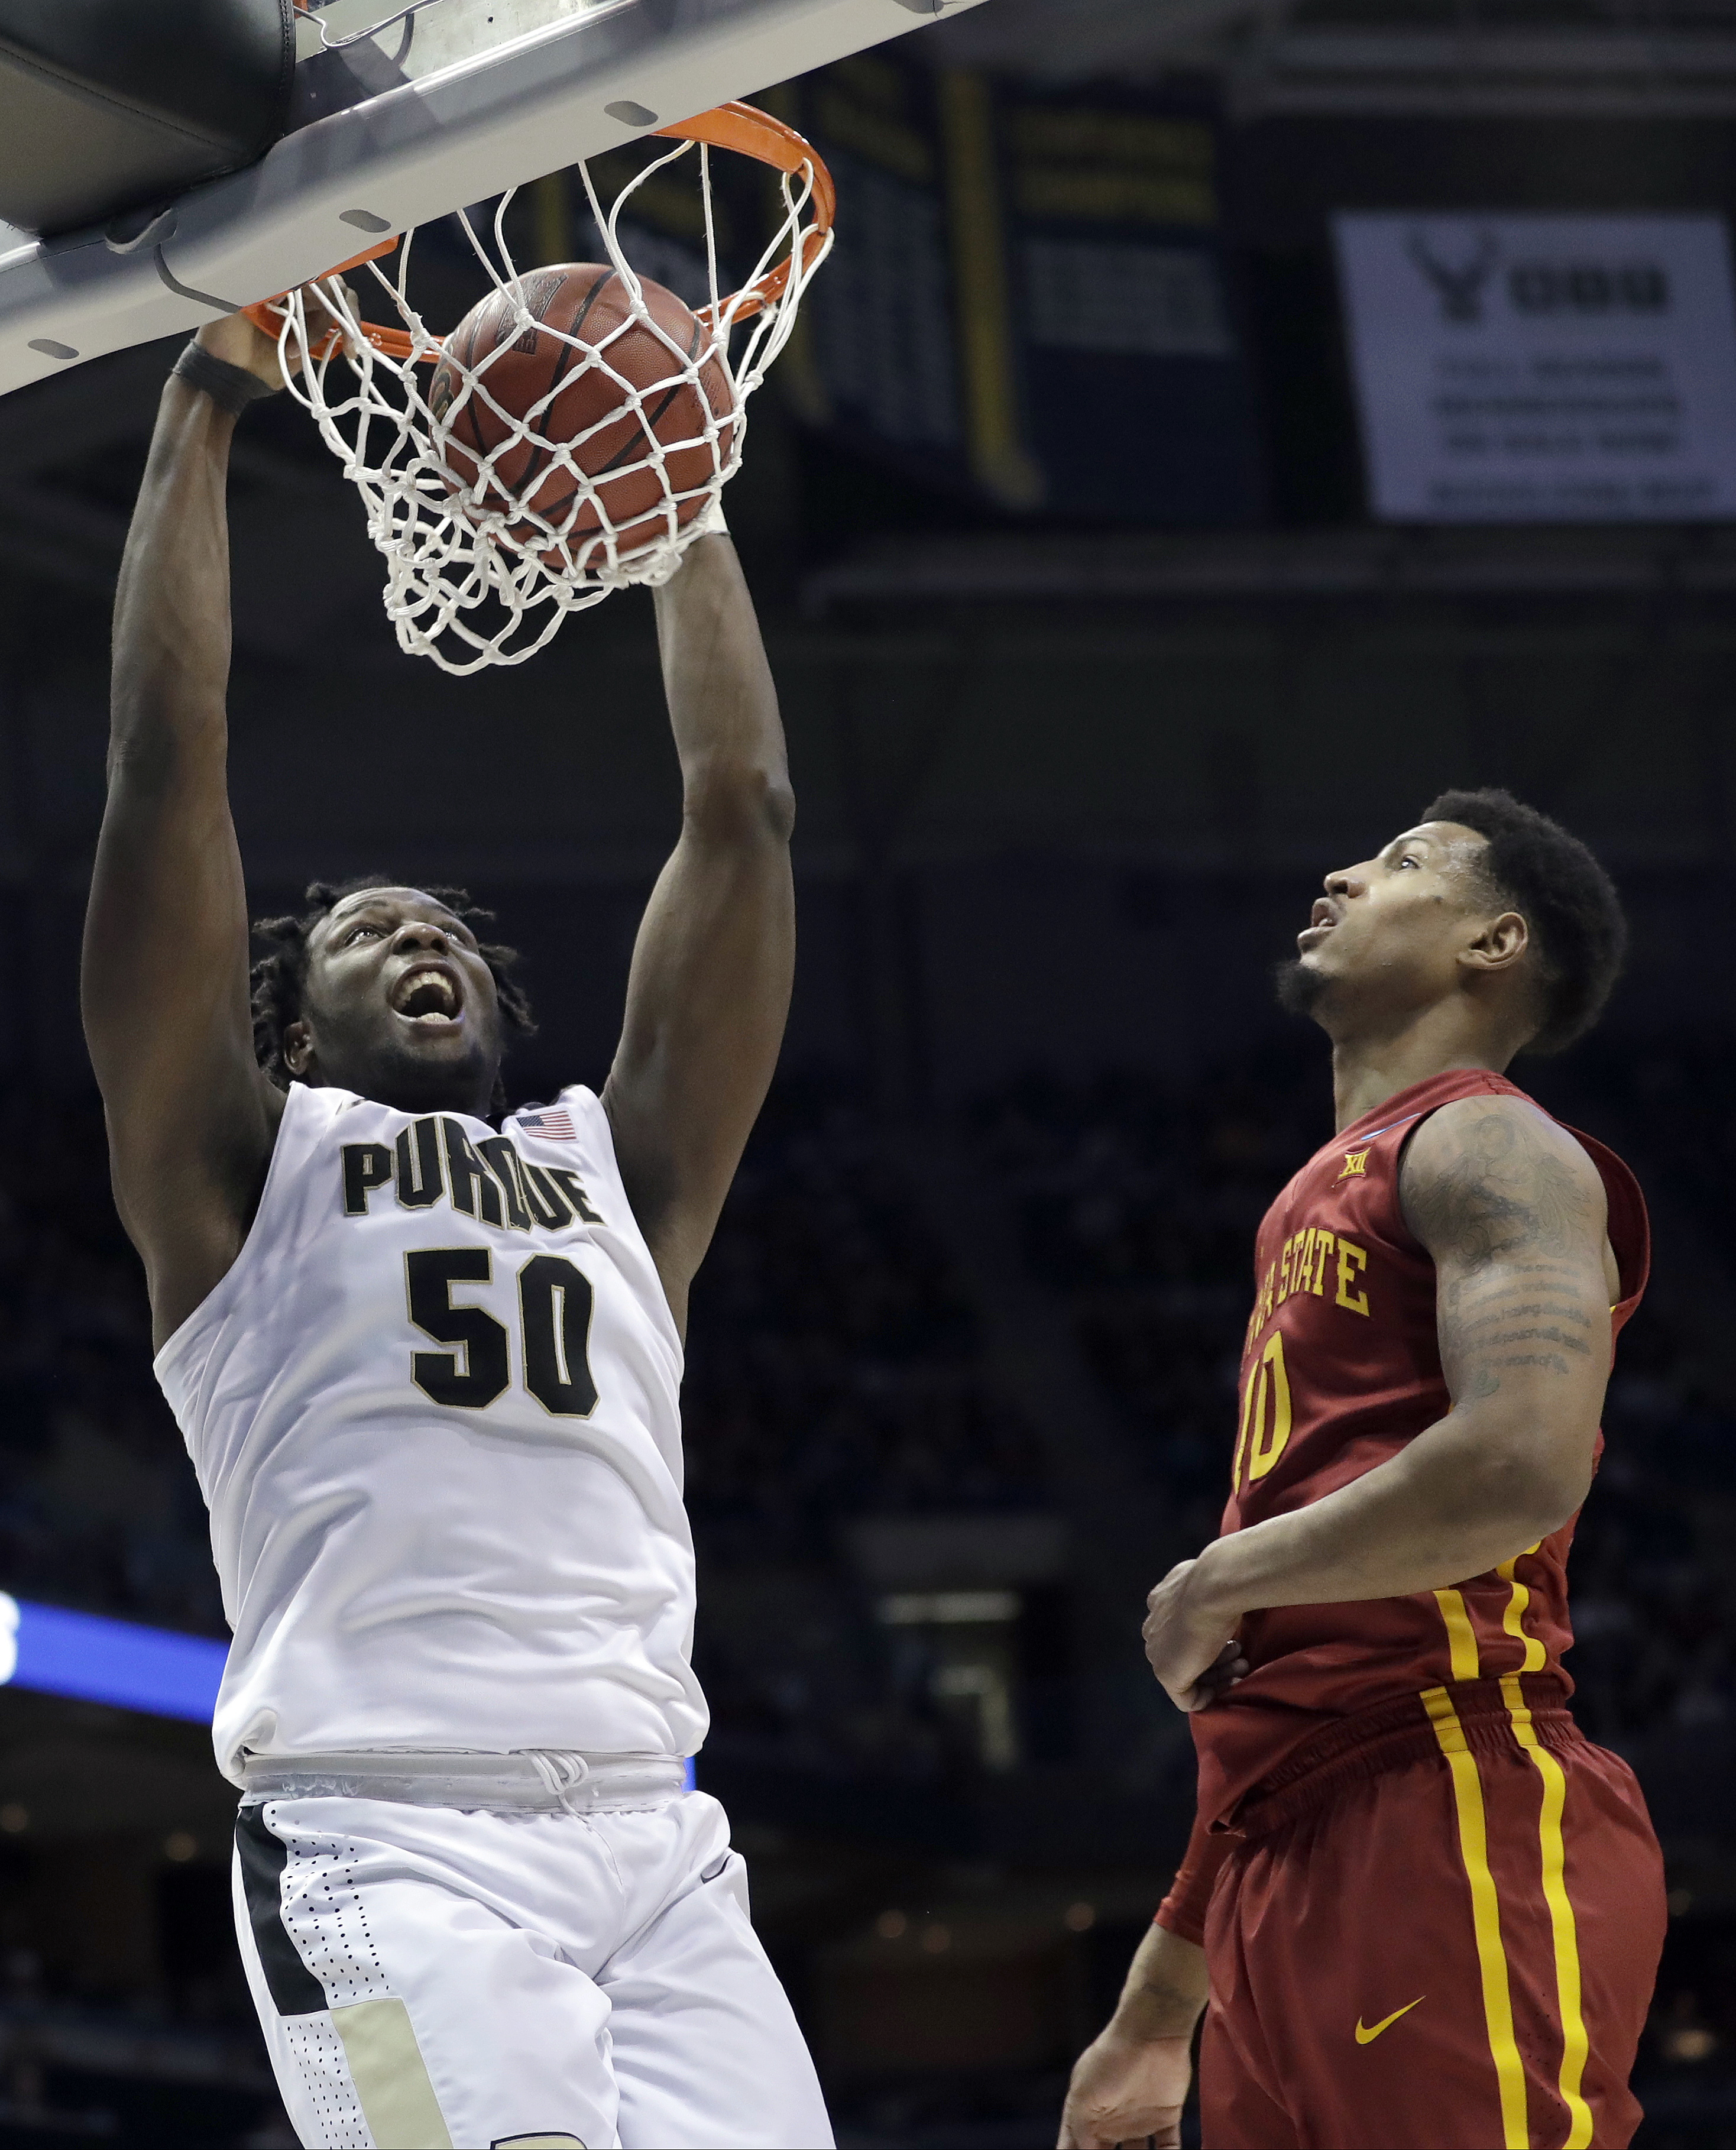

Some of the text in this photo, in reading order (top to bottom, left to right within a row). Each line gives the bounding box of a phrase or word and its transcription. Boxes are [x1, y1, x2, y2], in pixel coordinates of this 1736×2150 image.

[341, 1115, 607, 1233] PURDUE
[1277, 1227, 1371, 1317] STATE
[403, 1245, 601, 1420] 50
